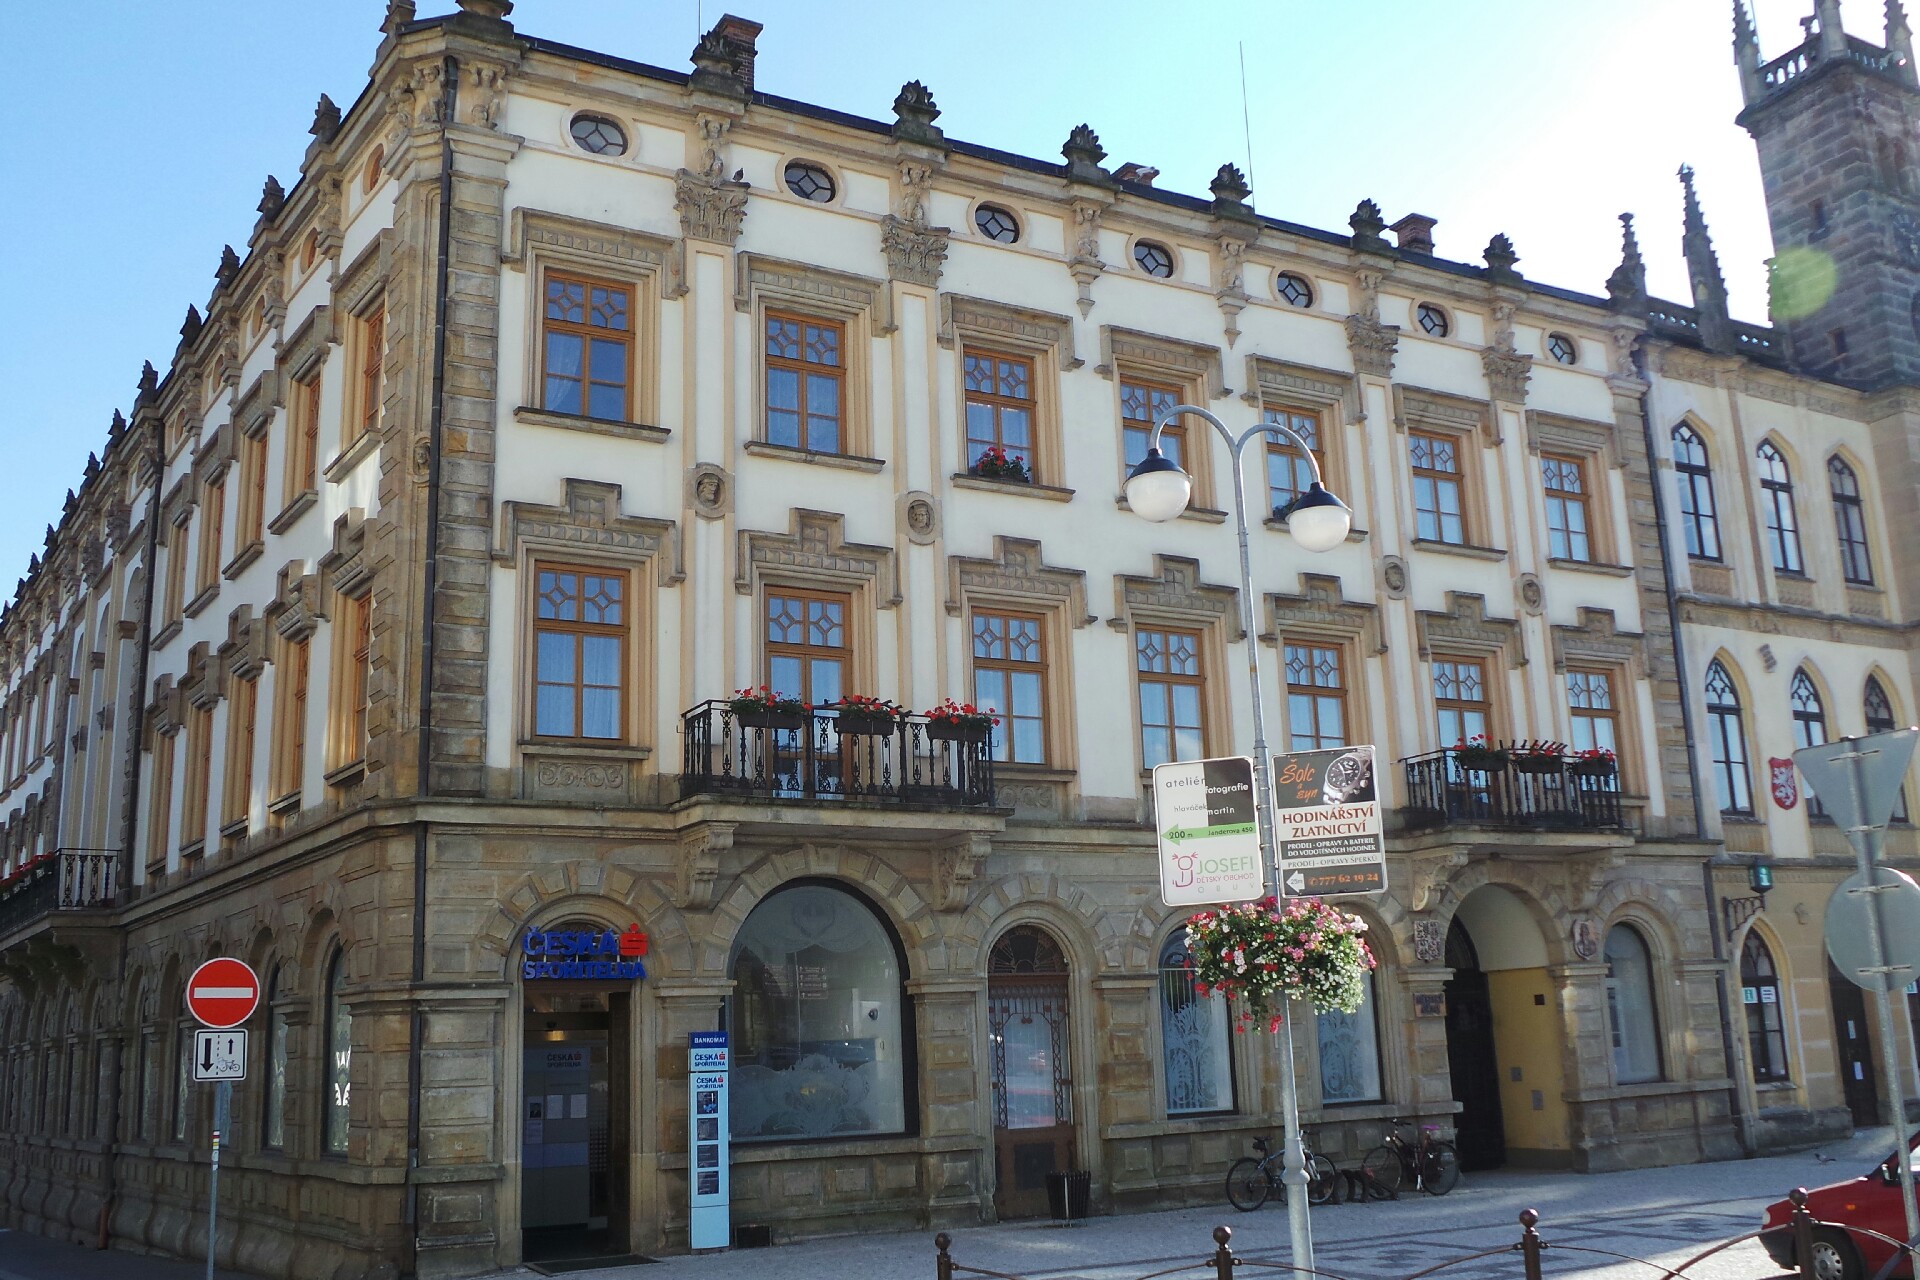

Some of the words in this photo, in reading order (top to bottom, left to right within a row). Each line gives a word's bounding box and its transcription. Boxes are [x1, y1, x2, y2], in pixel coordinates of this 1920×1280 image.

[1280, 758, 1315, 784] Šolc
[1165, 776, 1205, 788] ateliér
[1205, 782, 1249, 794] fotografie
[1296, 788, 1318, 802] syn
[1207, 806, 1235, 816] martin
[1282, 804, 1374, 824] HODINÁŘSTVÍ
[1169, 830, 1185, 839] 200
[1292, 820, 1367, 838] ZLATNICTVÍ
[1287, 842, 1312, 850] PRODEJ
[1287, 849, 1298, 857] DO
[1346, 844, 1376, 853] HODINEK
[1197, 856, 1254, 875] JOSEFI
[1287, 860, 1314, 868] PRODEJ
[1319, 876, 1335, 886] 777
[1366, 873, 1379, 881] 24
[523, 925, 619, 956] ČESKÁ
[523, 957, 647, 980] SPOŘITELNA
[694, 1053, 718, 1061] ČESKÁ
